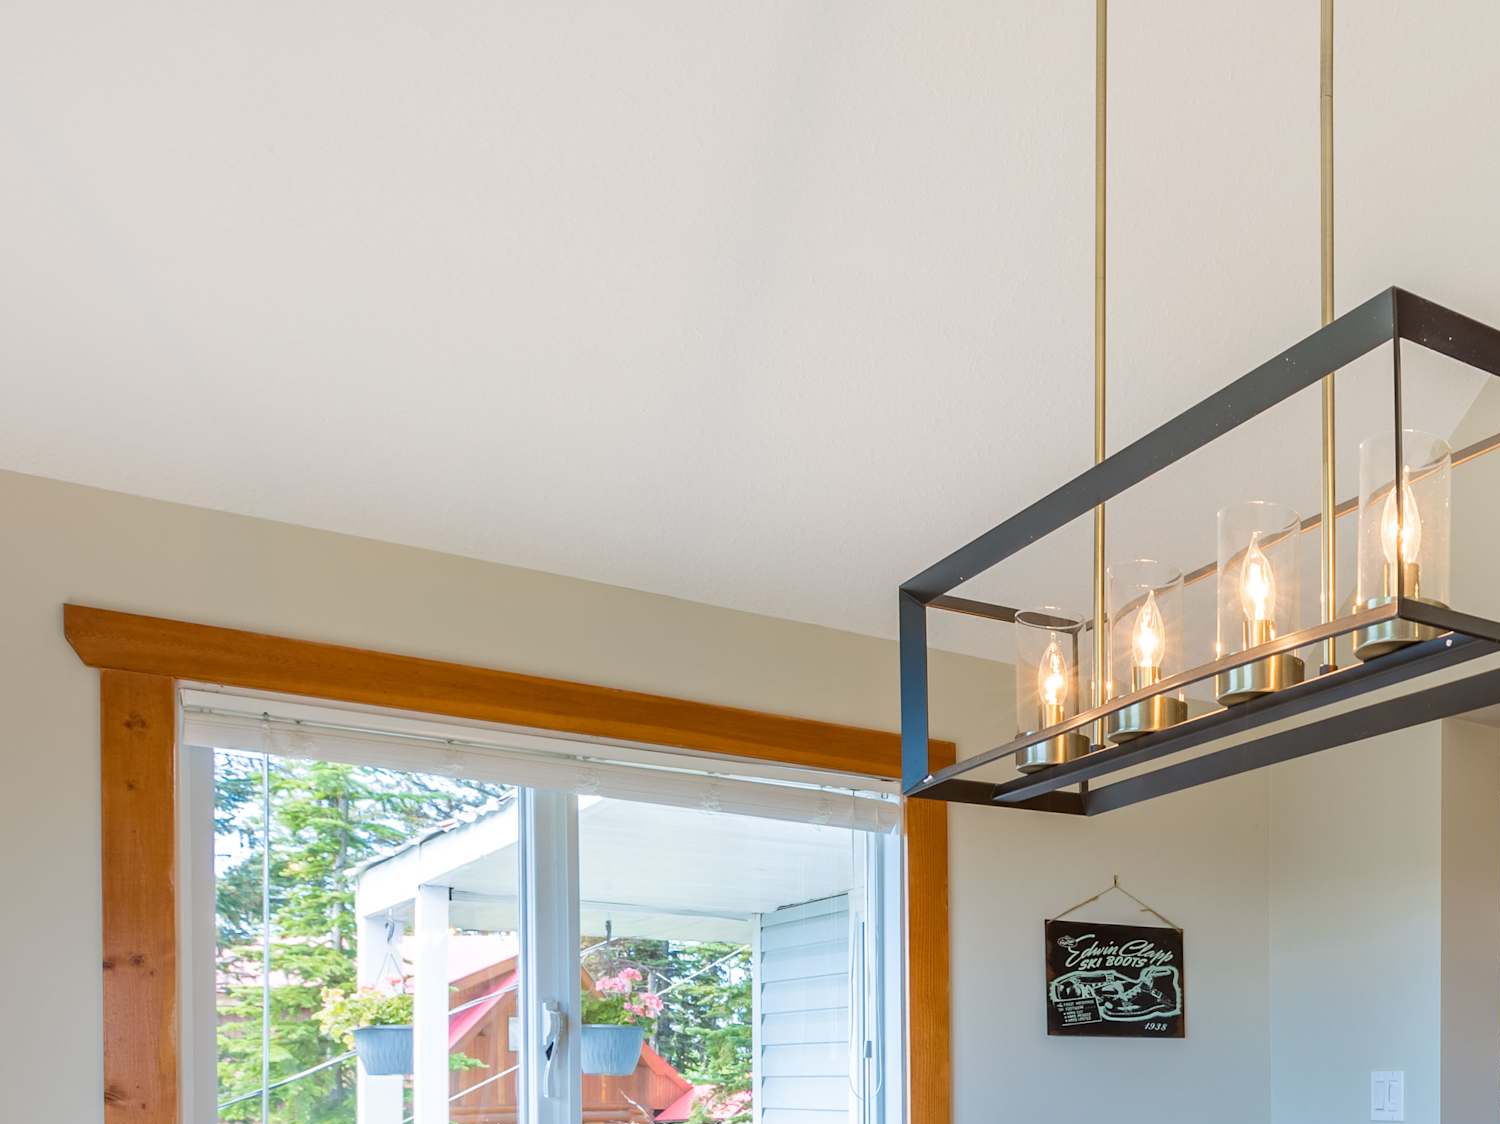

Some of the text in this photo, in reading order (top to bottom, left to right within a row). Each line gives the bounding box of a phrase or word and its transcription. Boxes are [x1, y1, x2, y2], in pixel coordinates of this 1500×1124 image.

[1065, 934, 1118, 967] Edwin
[1119, 940, 1174, 966] Clapp
[1078, 956, 1148, 970] SKI BOOTS
[1144, 1022, 1168, 1032] 1938
